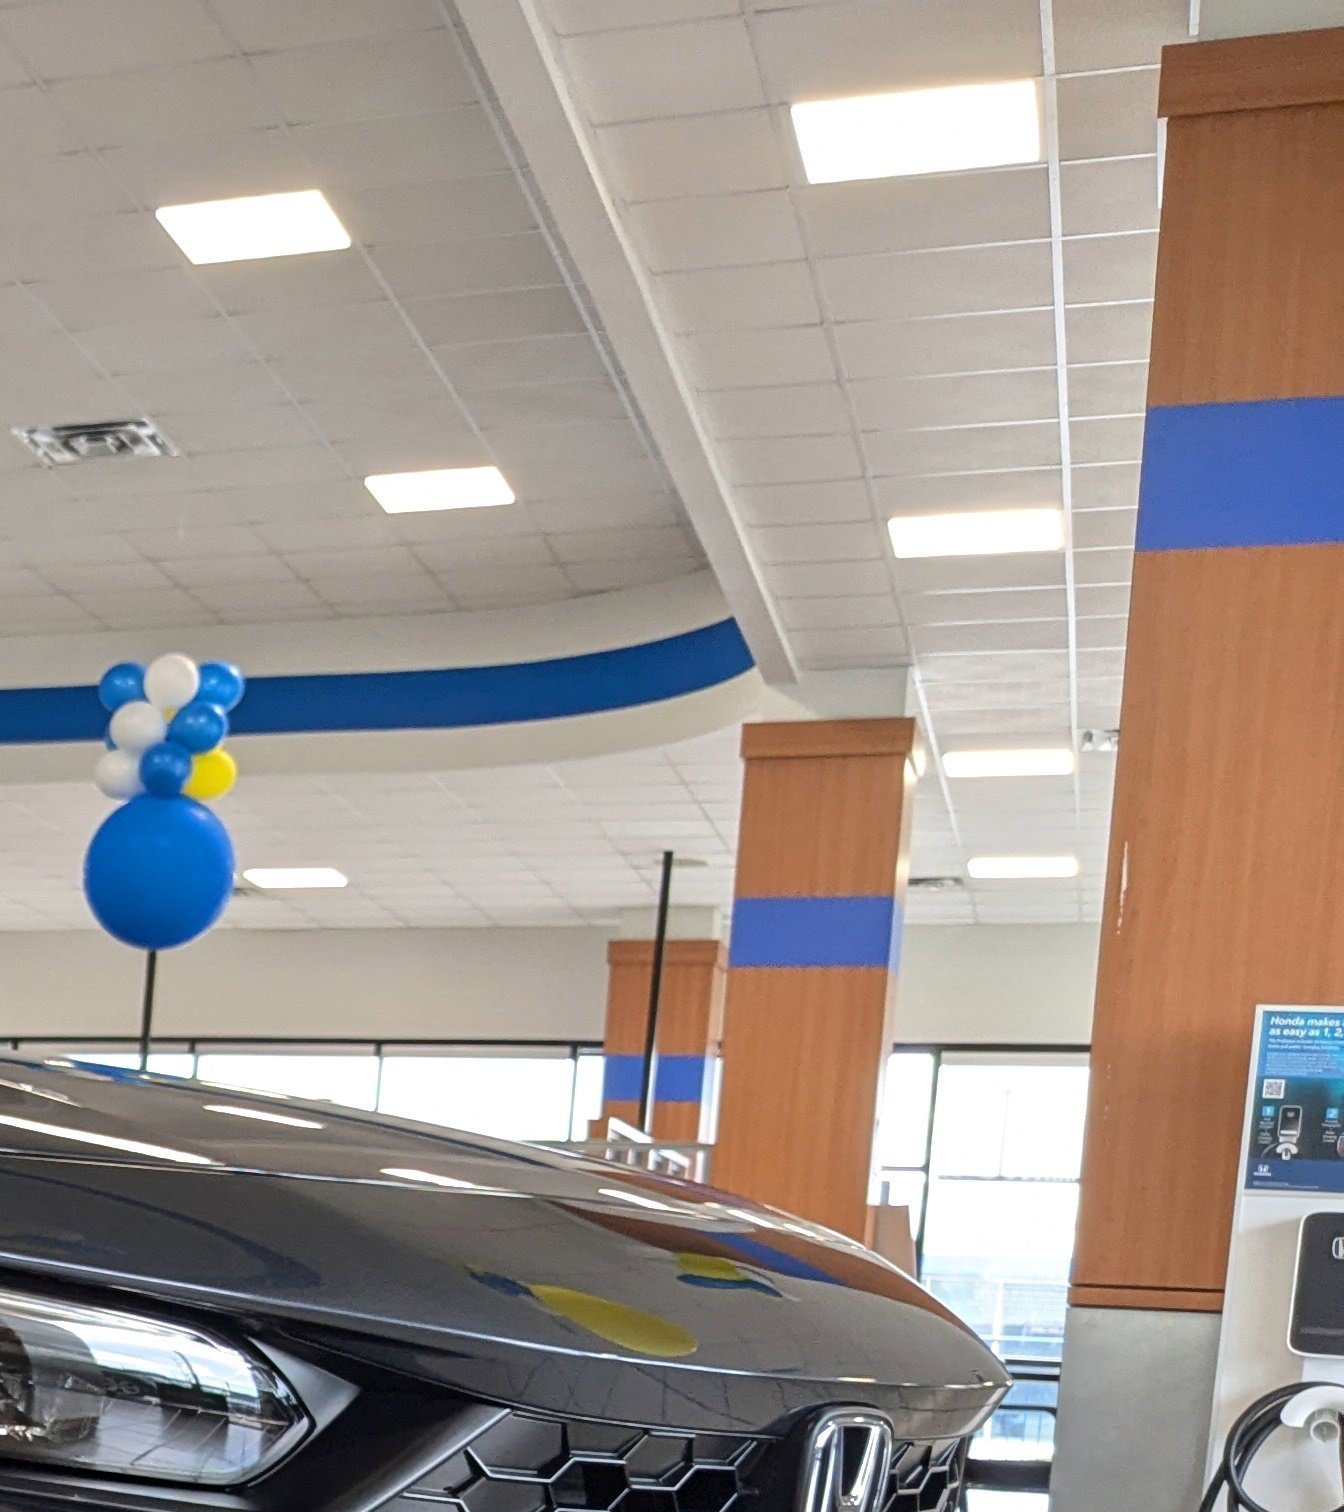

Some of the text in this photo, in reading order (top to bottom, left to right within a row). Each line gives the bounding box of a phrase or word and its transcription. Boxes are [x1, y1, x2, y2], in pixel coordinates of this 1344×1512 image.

[1270, 1016, 1341, 1027] Honda makes
[1269, 1027, 1281, 1036] as
[1283, 1028, 1307, 1038] easy
[1308, 1028, 1320, 1036] as
